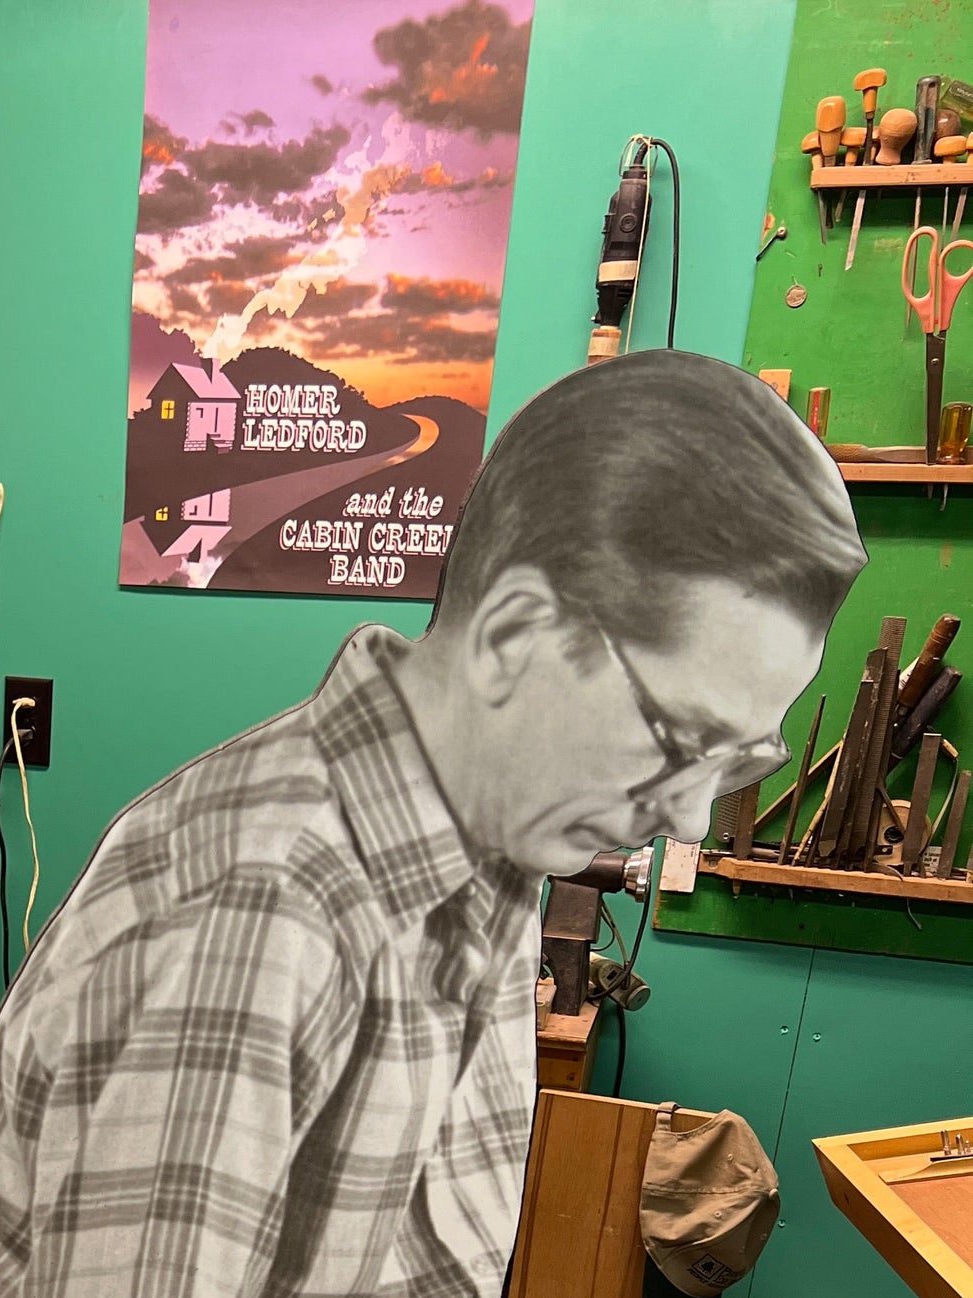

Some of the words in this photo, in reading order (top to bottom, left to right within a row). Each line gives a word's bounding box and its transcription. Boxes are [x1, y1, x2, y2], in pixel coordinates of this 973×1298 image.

[244, 384, 340, 417] HOMER
[241, 419, 367, 452] LEDFORD
[343, 486, 395, 518] and
[399, 486, 444, 519] the
[280, 520, 364, 551] CABIN
[328, 555, 405, 587] BAND
